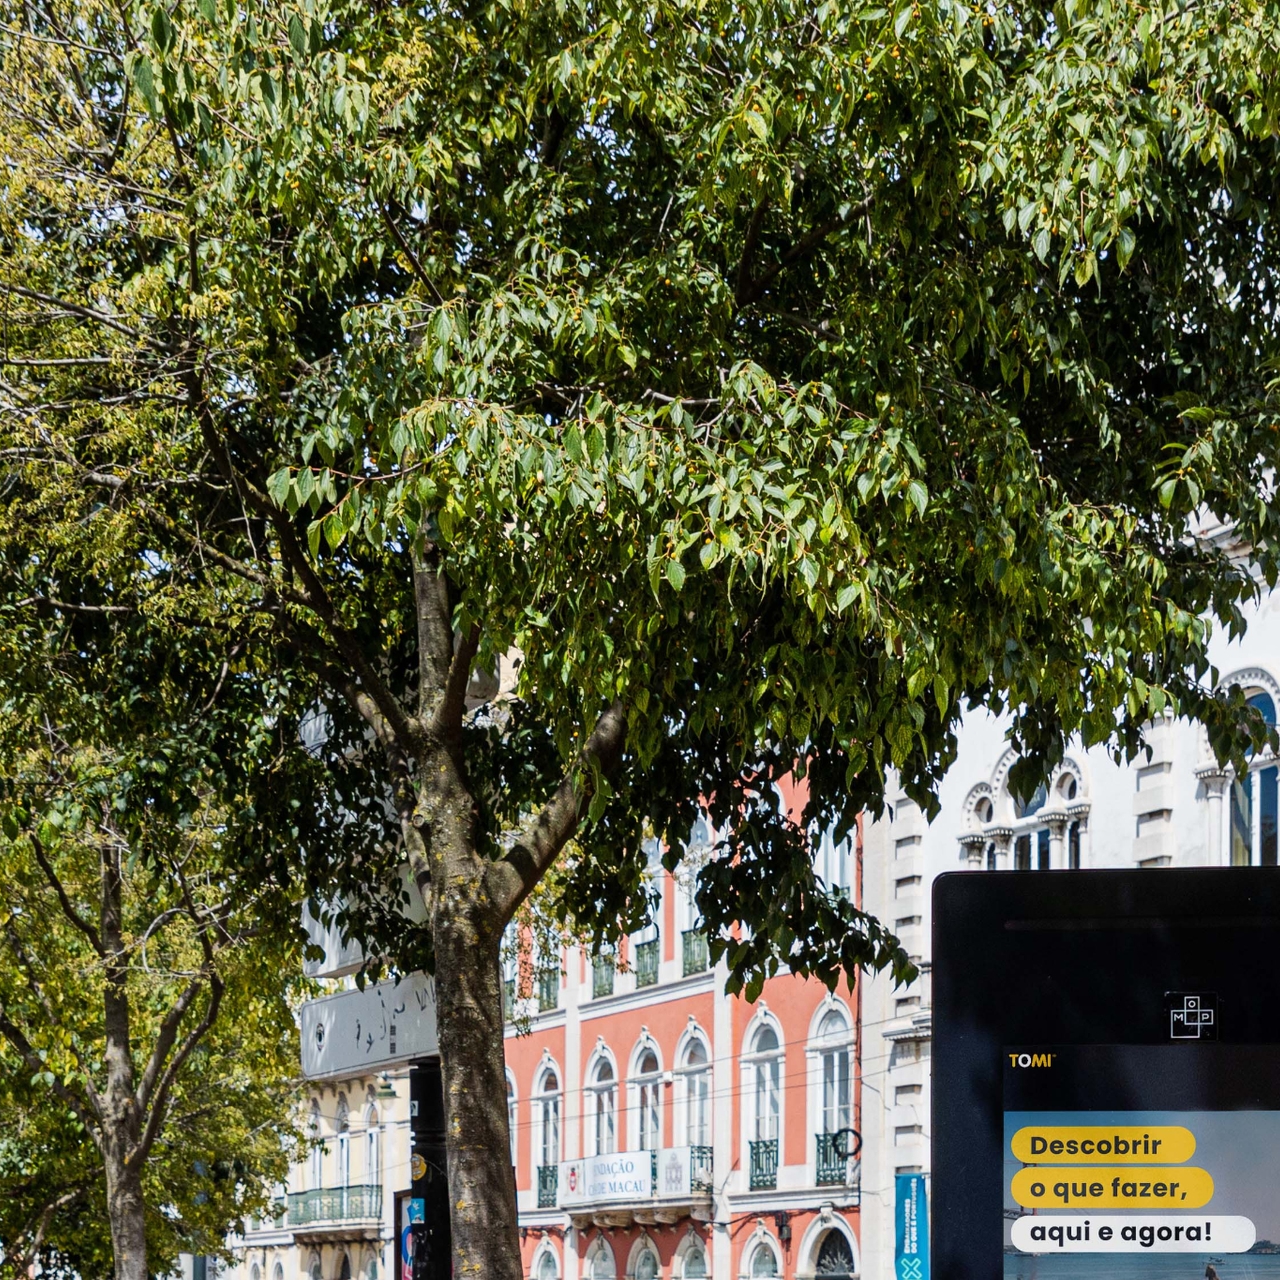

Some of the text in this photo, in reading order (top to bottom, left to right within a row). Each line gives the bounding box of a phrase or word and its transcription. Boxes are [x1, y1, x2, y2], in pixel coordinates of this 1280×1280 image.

[1031, 1134, 1162, 1155] Descobrir
[1030, 1177, 1187, 1203] o que fazer,
[1030, 1220, 1212, 1248] aqui e agora!
